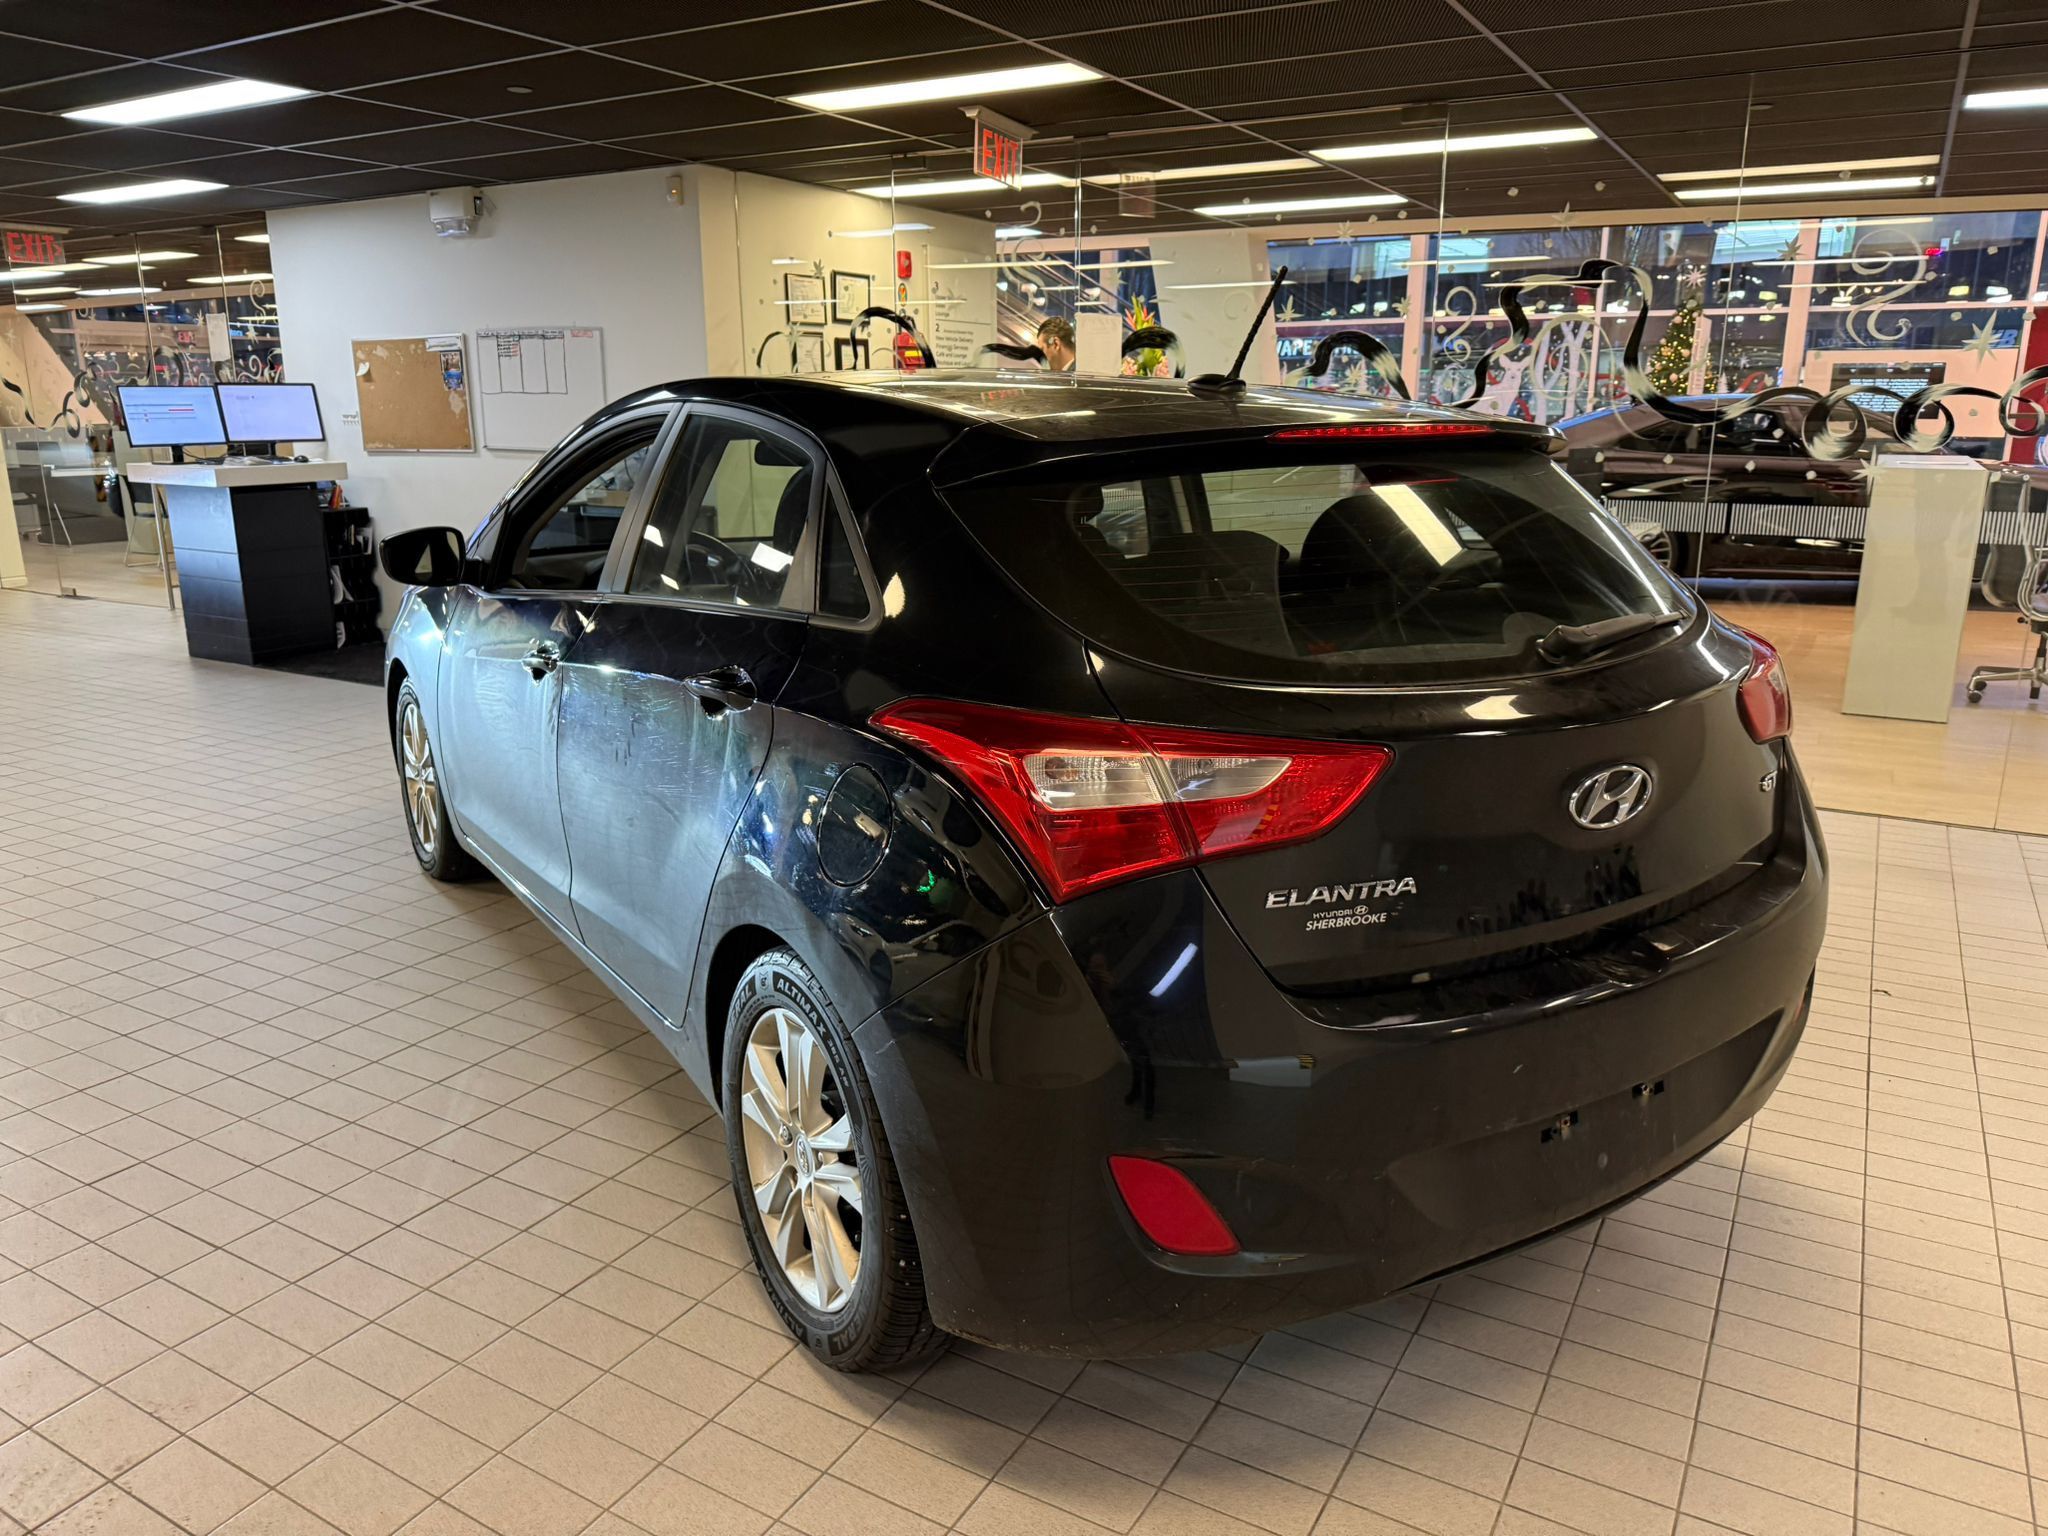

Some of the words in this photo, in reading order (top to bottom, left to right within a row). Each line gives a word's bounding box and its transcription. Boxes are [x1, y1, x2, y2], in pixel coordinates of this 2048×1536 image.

[982, 128, 1019, 185] EXIT
[6, 231, 55, 265] EXIT
[935, 323, 941, 332] 2
[1265, 876, 1417, 909] ELANTRA
[1305, 912, 1387, 931] SHERBROOKE
[1312, 909, 1353, 919] HYUNDAI
[776, 978, 827, 1037] ALTIMAX
